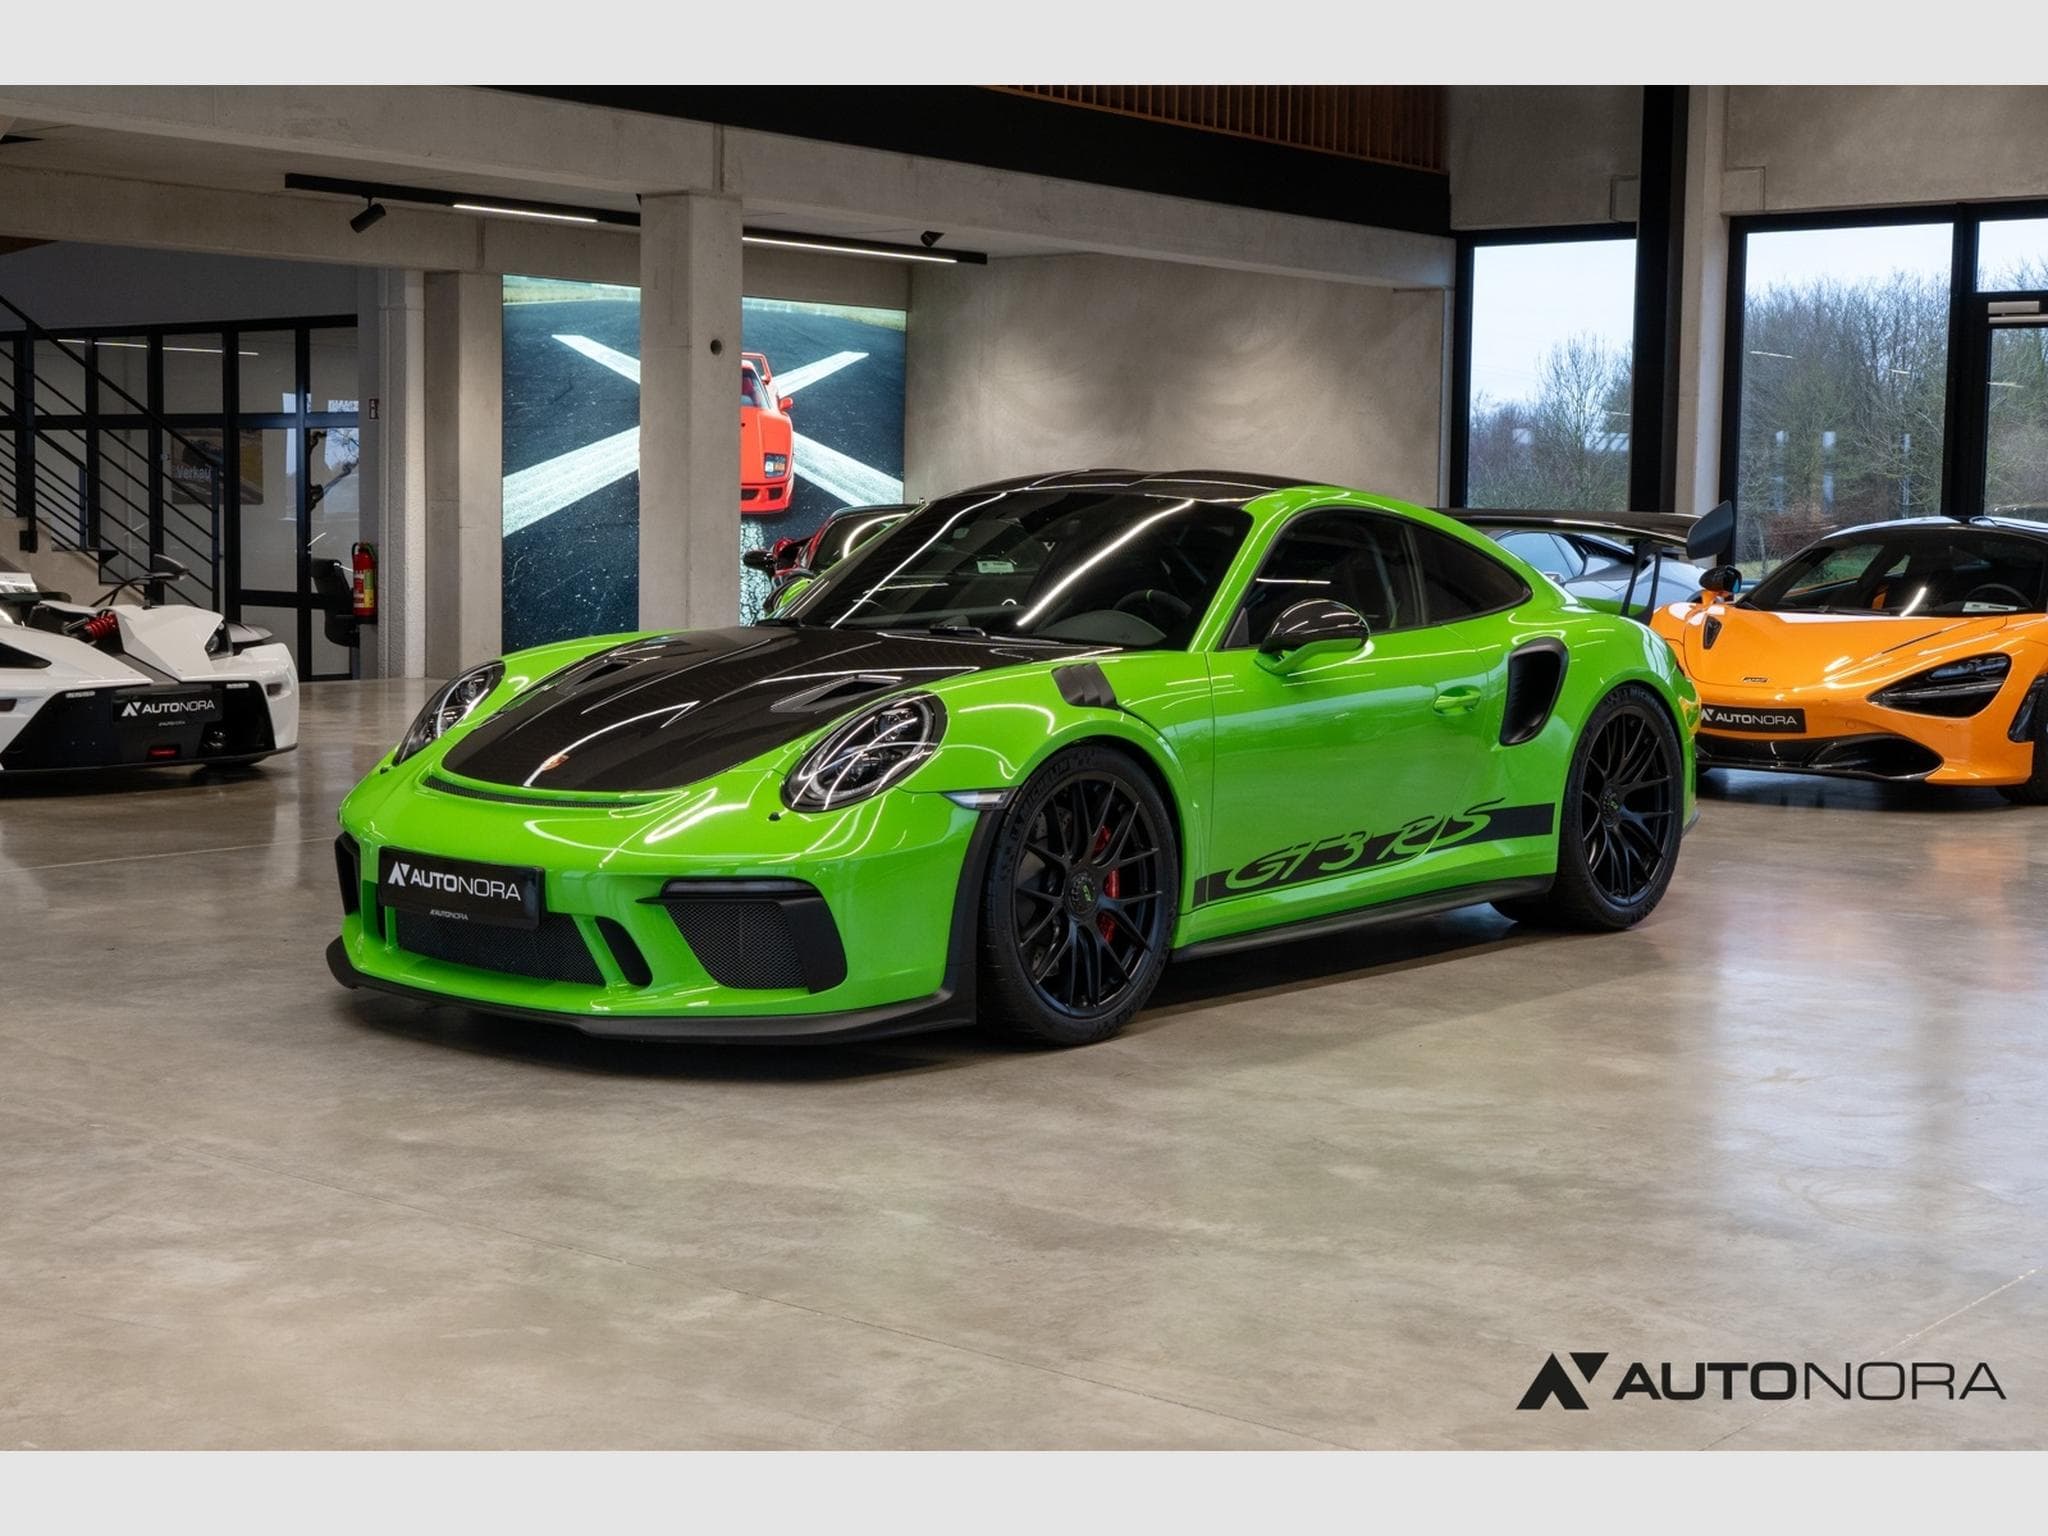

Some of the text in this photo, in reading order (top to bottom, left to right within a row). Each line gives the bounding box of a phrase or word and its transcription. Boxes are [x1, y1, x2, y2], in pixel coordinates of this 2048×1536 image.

[175, 464, 212, 480] Verkau
[141, 700, 216, 714] AUTONORA
[1715, 712, 1798, 726] AUTONORA
[1224, 797, 1506, 890] GT3 RS
[409, 867, 522, 901] AUTONORA
